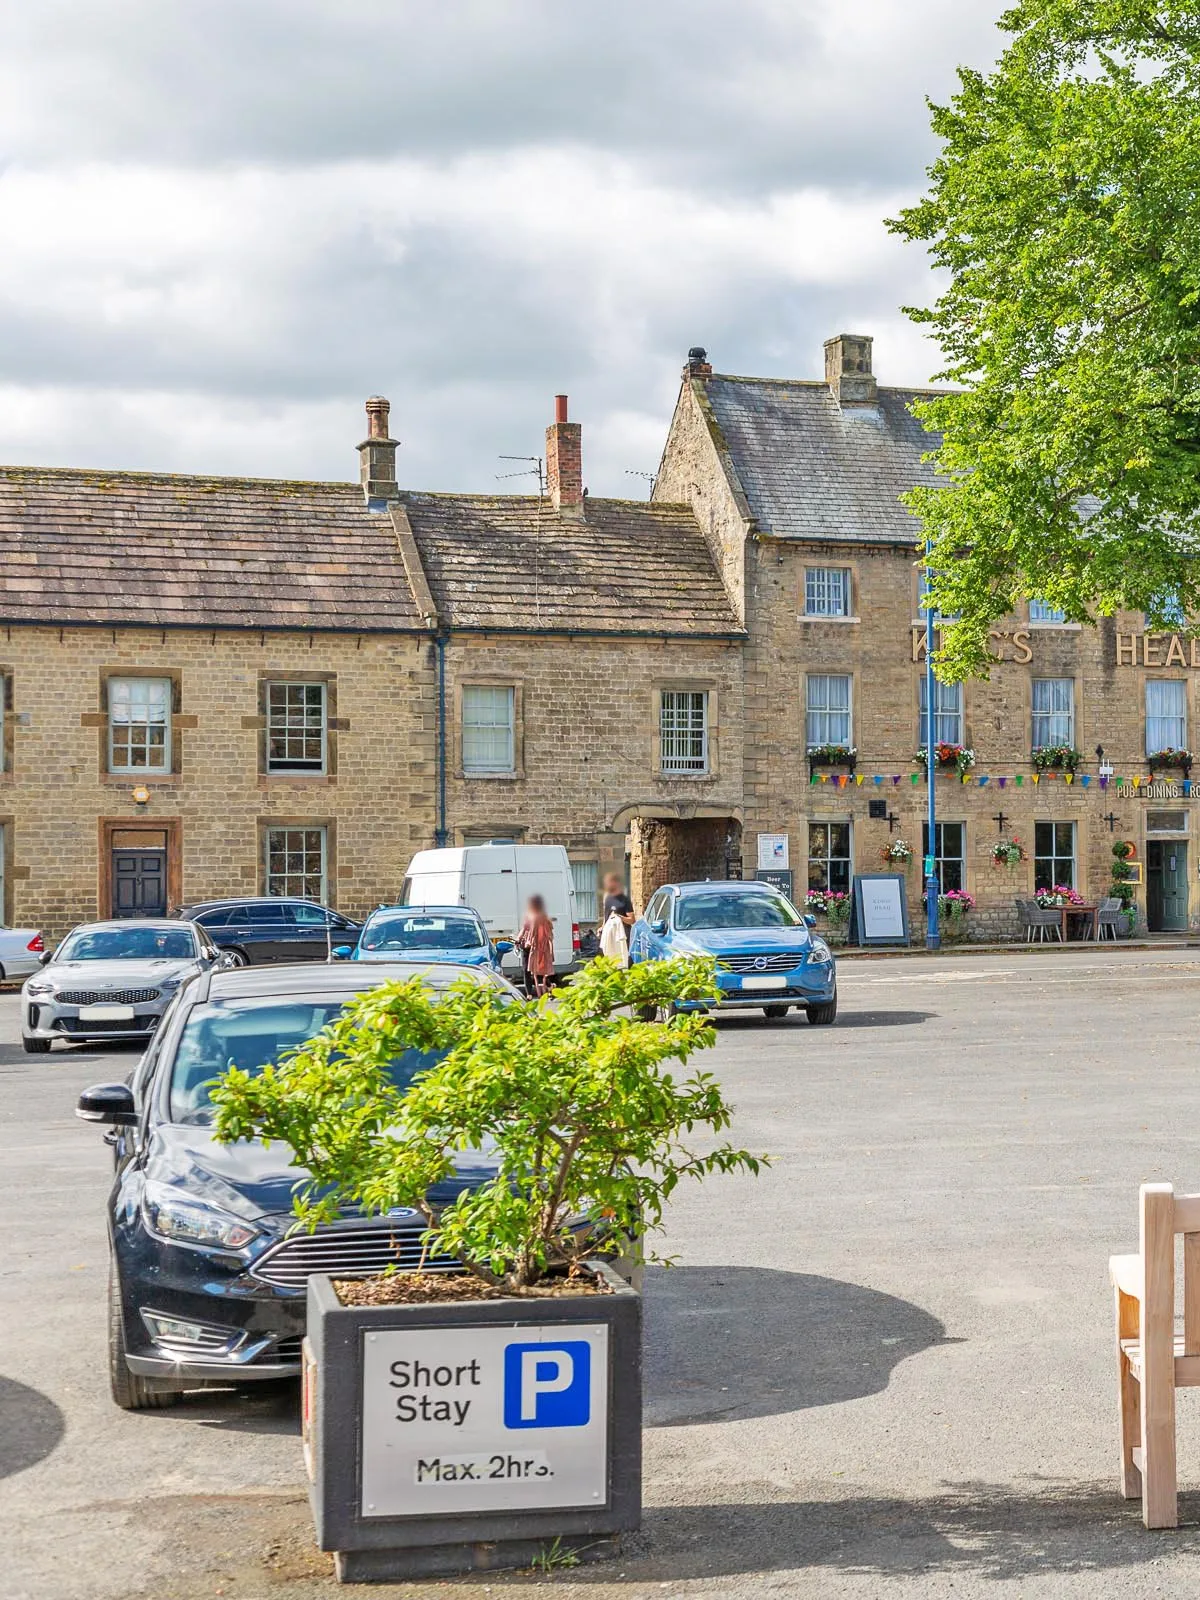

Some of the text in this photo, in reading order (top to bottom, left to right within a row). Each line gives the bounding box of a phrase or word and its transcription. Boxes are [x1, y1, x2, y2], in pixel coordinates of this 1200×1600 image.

[1117, 785, 1136, 798] PUB
[1147, 785, 1178, 798] DINING
[389, 1358, 481, 1388] Short
[520, 1350, 574, 1421] P
[395, 1395, 472, 1426] Stay
[417, 1458, 481, 1482] Max.
